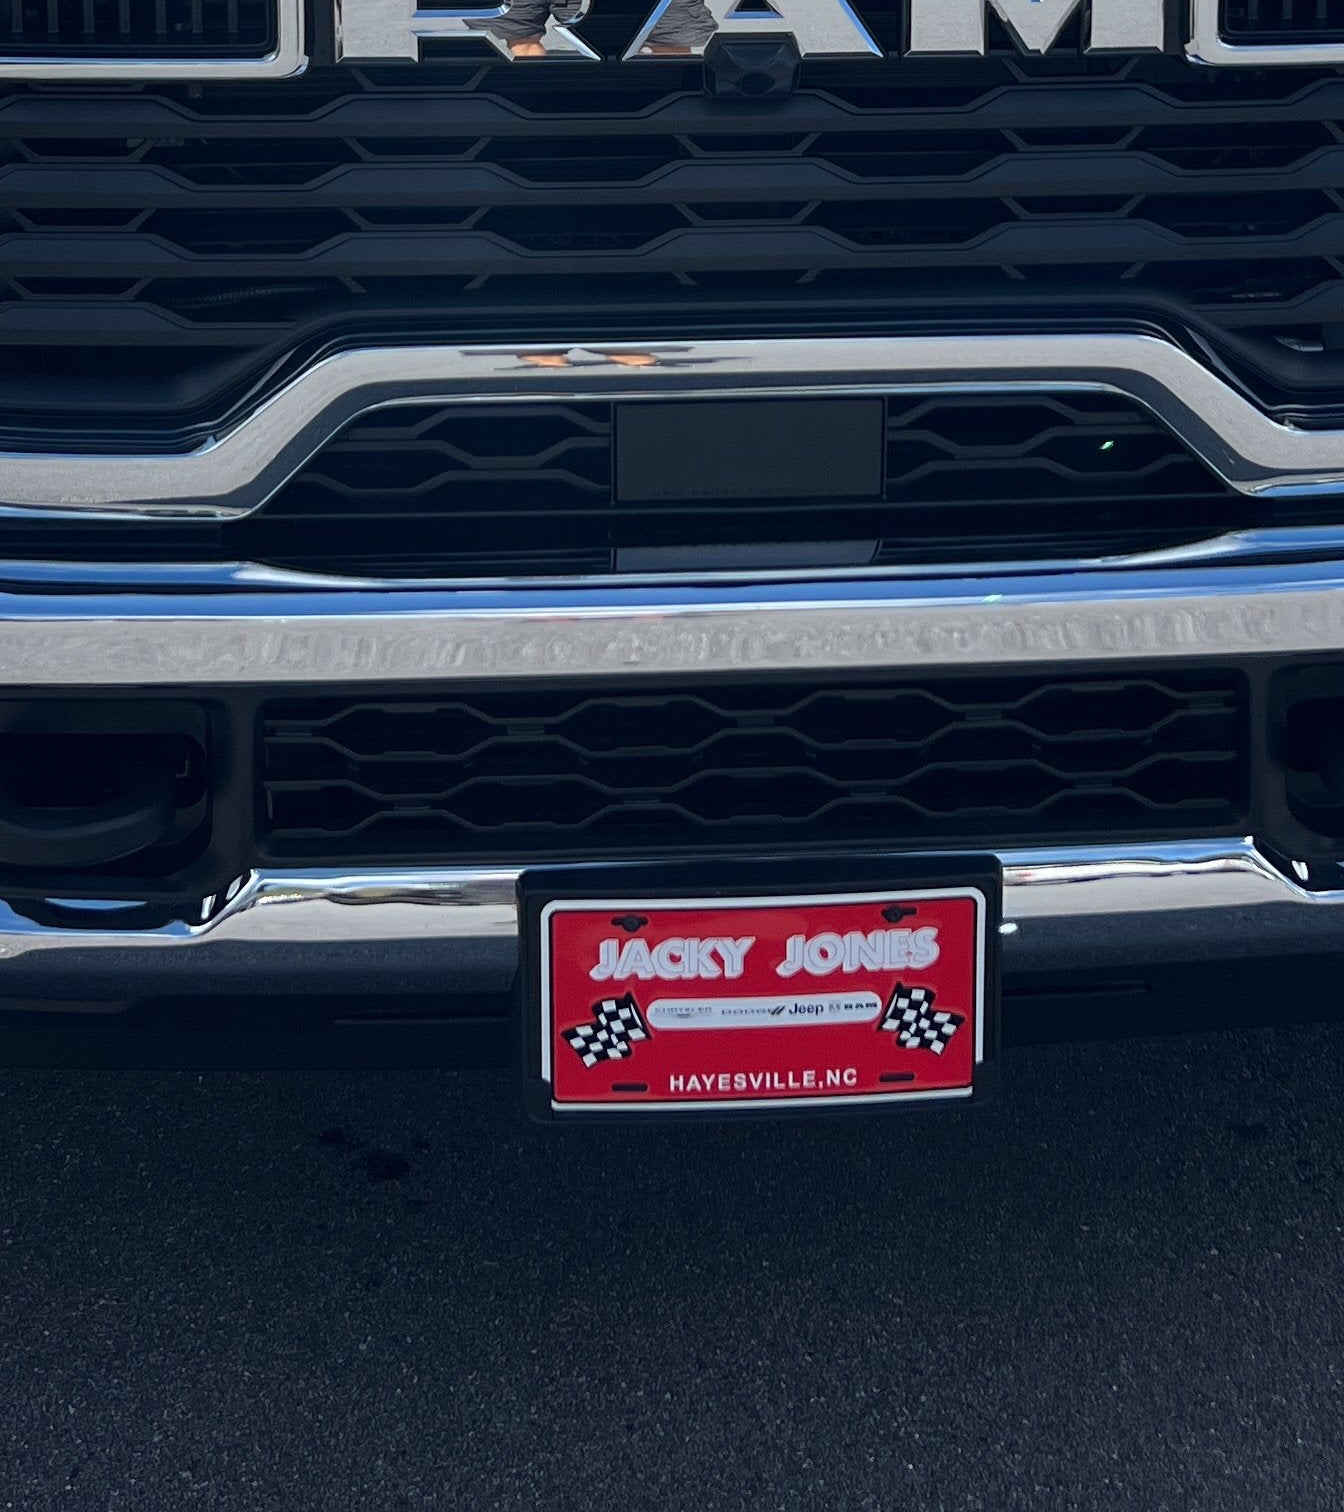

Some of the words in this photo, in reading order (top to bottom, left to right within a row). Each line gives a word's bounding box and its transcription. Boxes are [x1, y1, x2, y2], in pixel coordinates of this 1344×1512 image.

[589, 936, 756, 981] JACKY
[776, 926, 940, 978] JONES
[789, 1003, 824, 1016] Jeep
